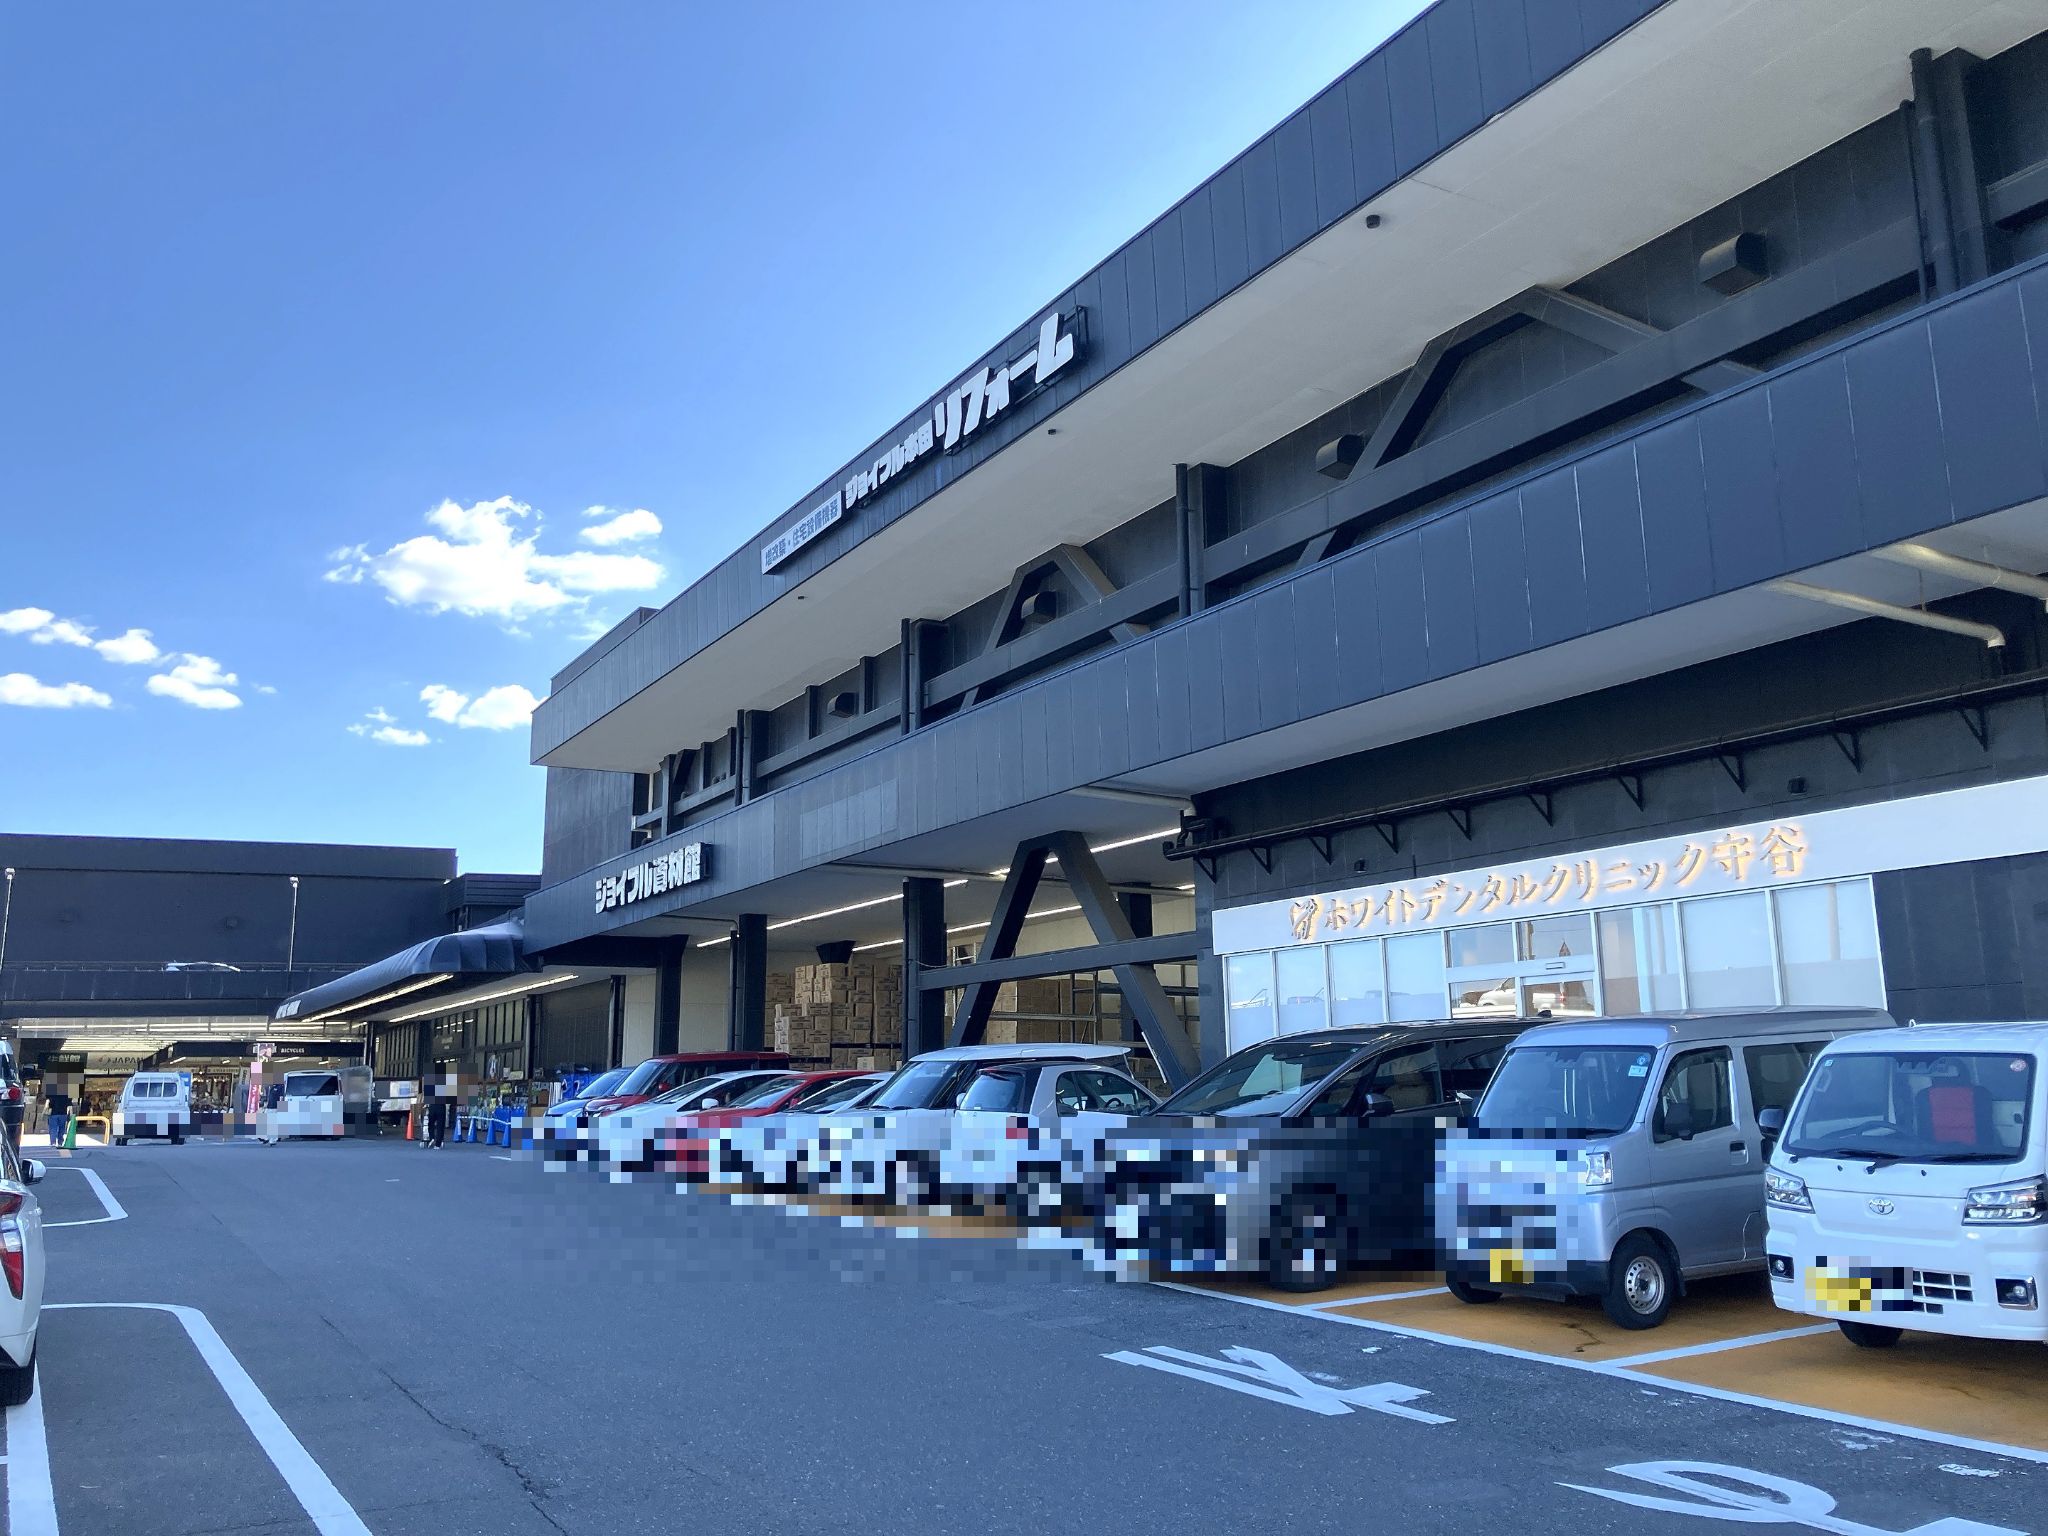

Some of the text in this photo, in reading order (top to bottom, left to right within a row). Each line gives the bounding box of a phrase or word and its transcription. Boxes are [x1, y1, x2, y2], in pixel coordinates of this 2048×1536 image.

[935, 312, 1074, 449] リフォーム
[1324, 825, 1806, 931] ホワイトデンタルクリニック守谷
